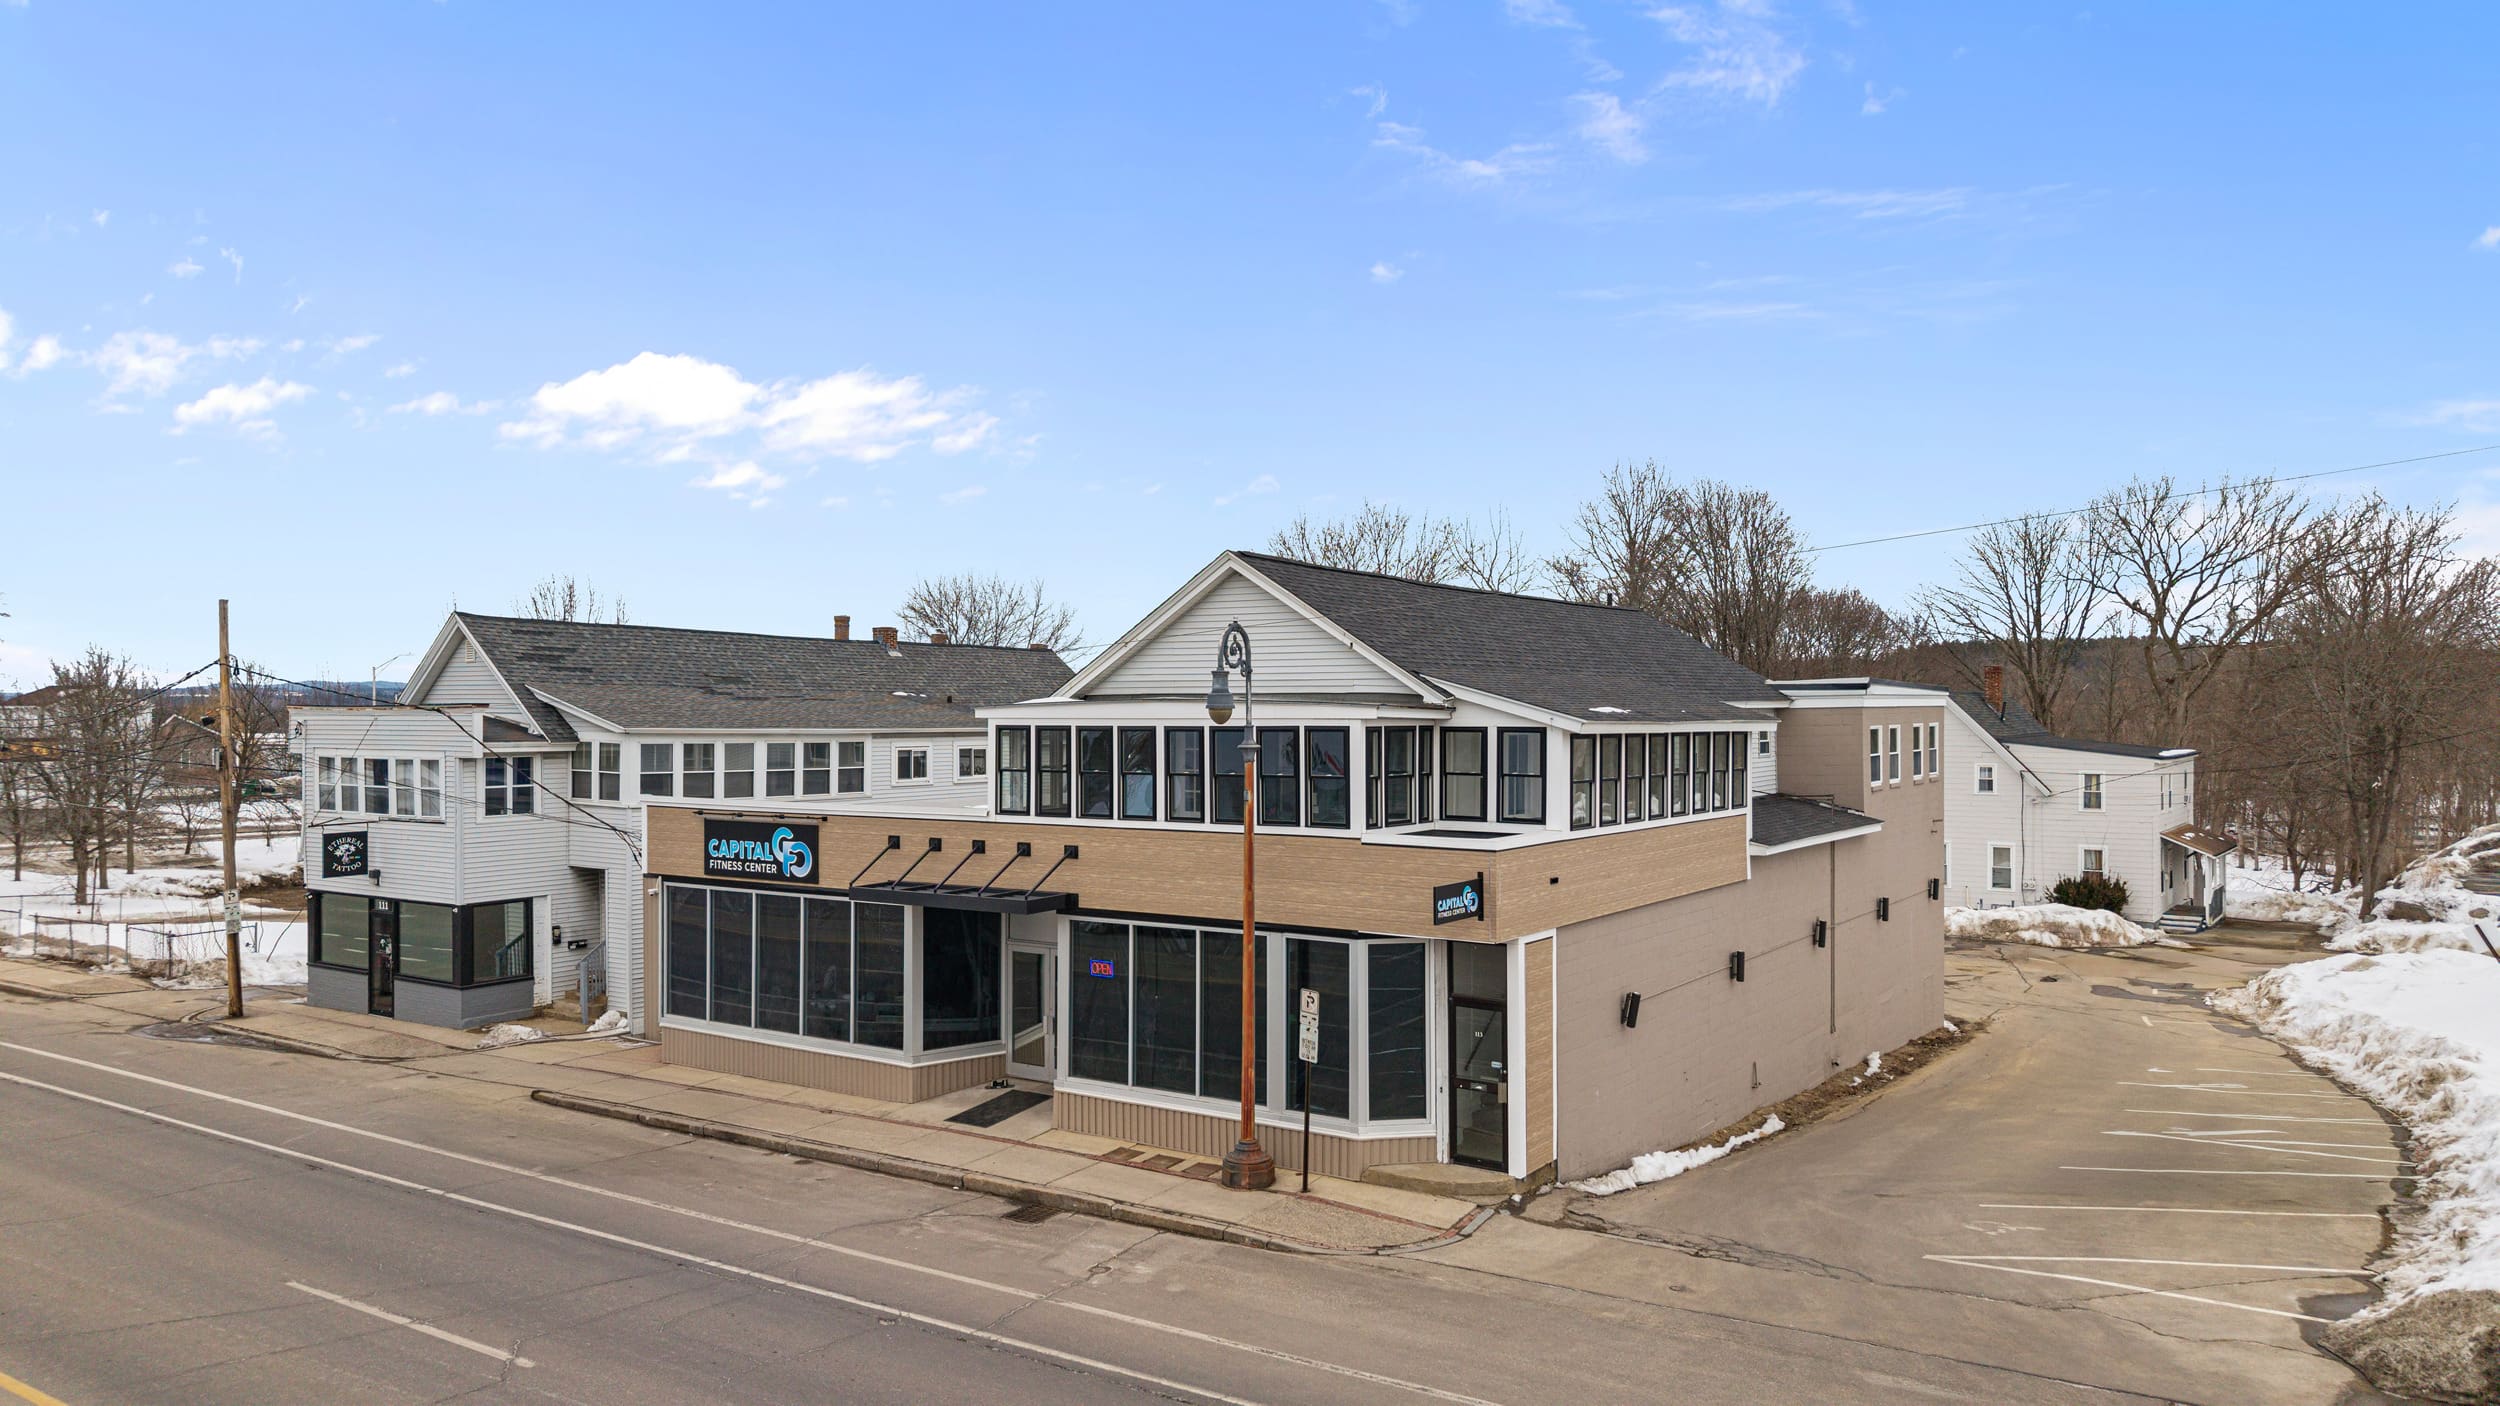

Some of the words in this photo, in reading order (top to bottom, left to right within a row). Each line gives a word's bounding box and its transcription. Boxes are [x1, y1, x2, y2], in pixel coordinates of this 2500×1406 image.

[327, 836, 365, 851] ETHEREAL
[708, 838, 774, 861] CAPITAL
[332, 861, 362, 872] TATTOO
[709, 859, 743, 871] FITNESS
[744, 862, 777, 874] CENTER
[378, 901, 389, 910] 111
[1437, 896, 1465, 911] CAPITAL
[1452, 907, 1466, 916] CENTER
[1092, 962, 1112, 975] OPEN
